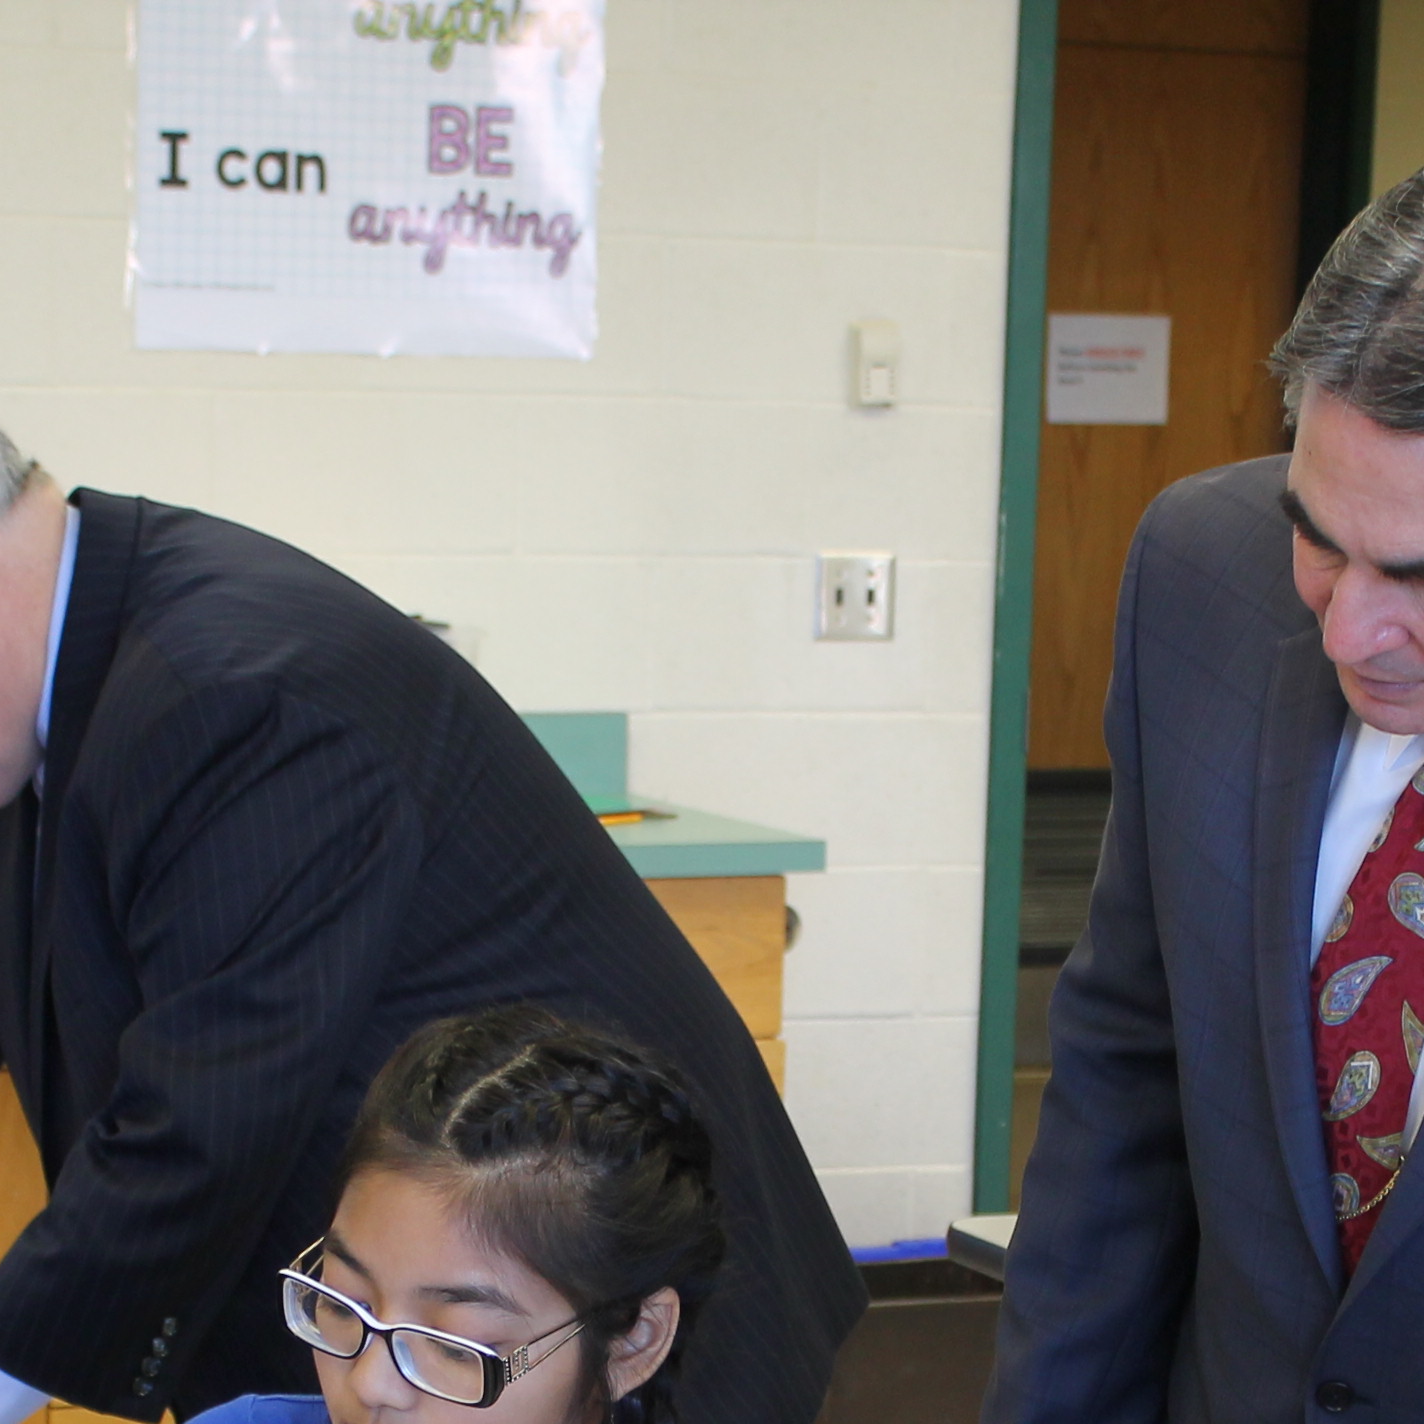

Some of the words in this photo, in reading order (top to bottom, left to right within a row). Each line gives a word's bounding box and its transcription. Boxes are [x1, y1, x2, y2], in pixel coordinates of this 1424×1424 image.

[159, 131, 189, 189] I
[216, 148, 327, 193] can
[427, 103, 514, 176] BE
[348, 190, 582, 280] anything
